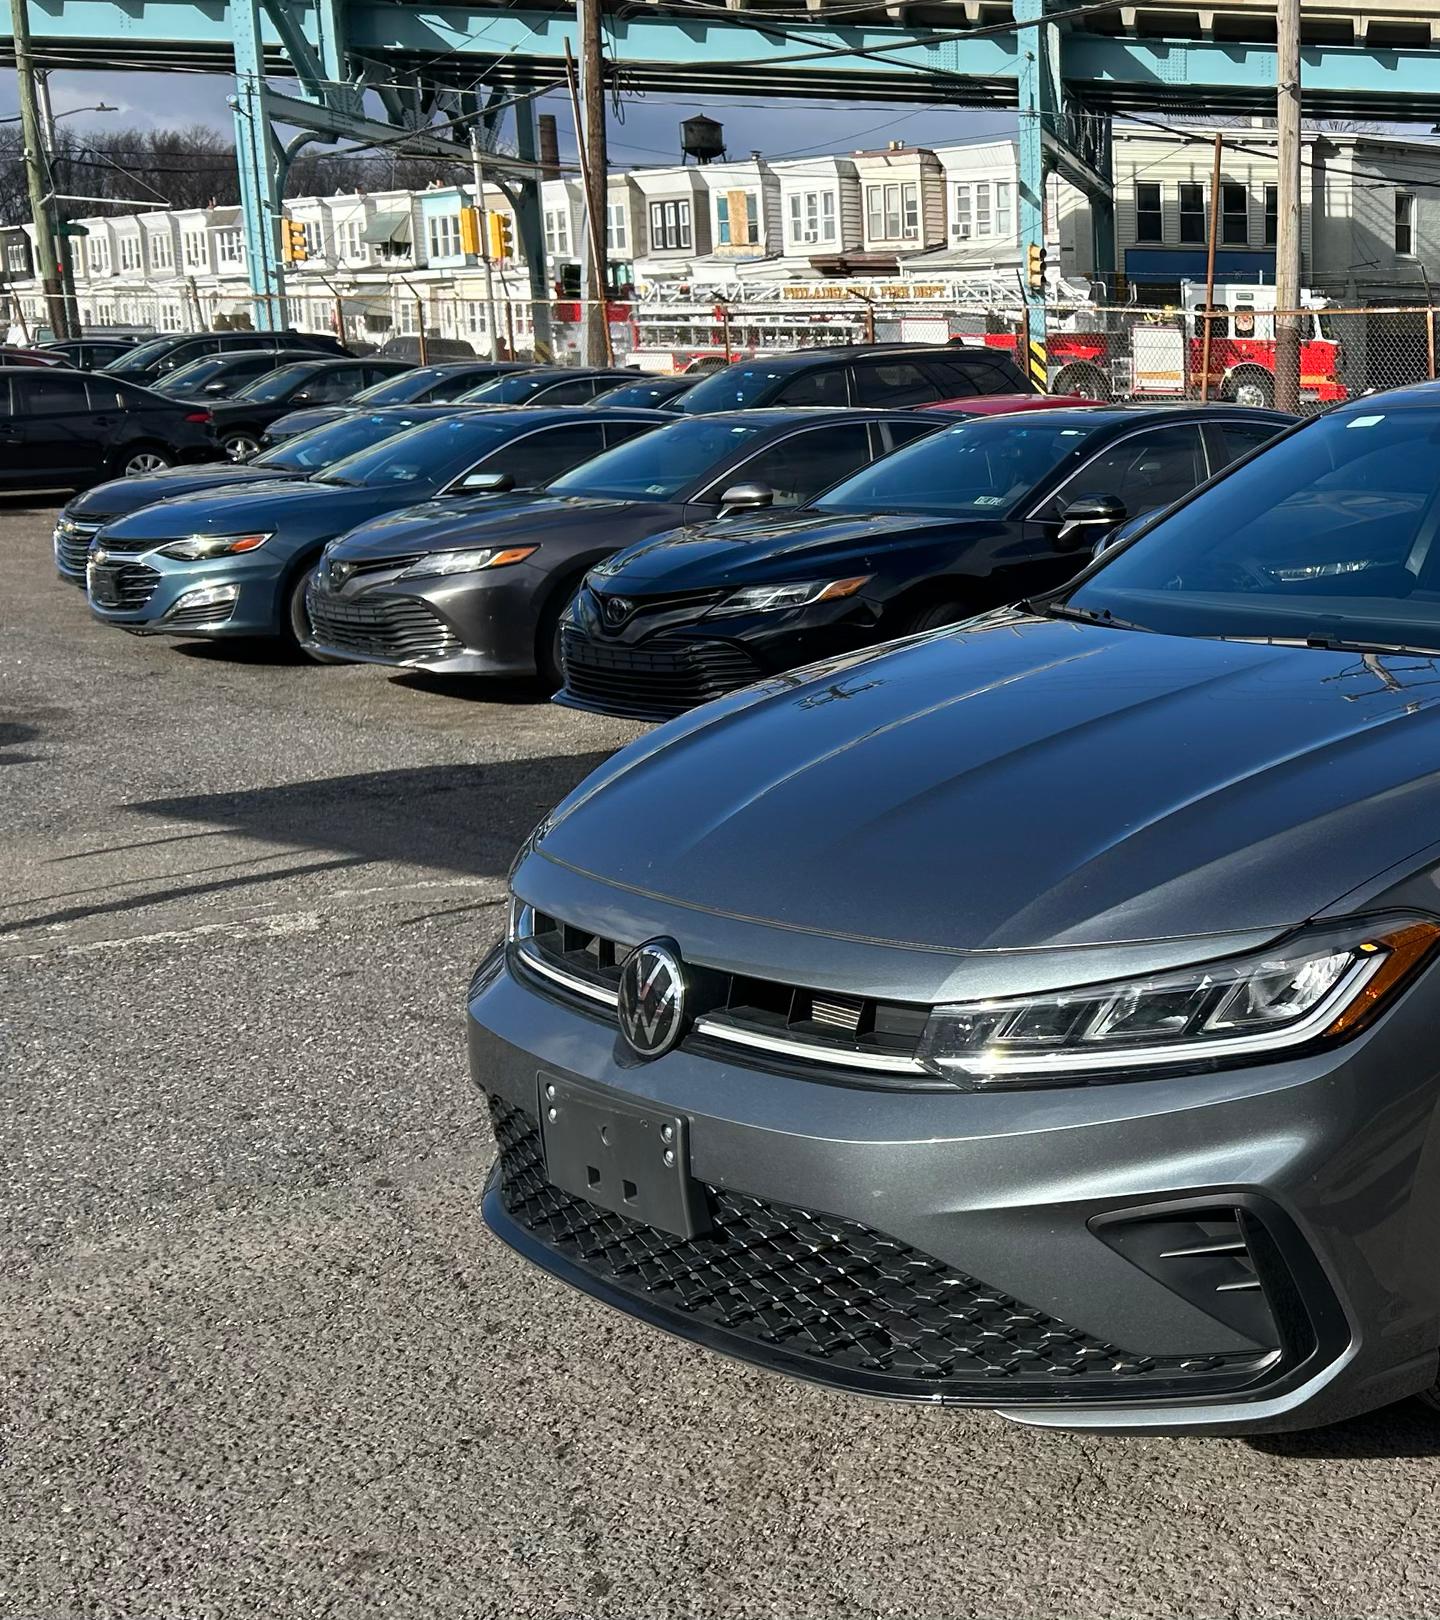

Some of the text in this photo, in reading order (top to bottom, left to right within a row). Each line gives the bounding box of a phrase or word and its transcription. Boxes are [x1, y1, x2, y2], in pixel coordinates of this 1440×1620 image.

[782, 286, 877, 300] PHILADELPHIA
[880, 286, 909, 299] FIRE
[621, 945, 683, 1053] VW
